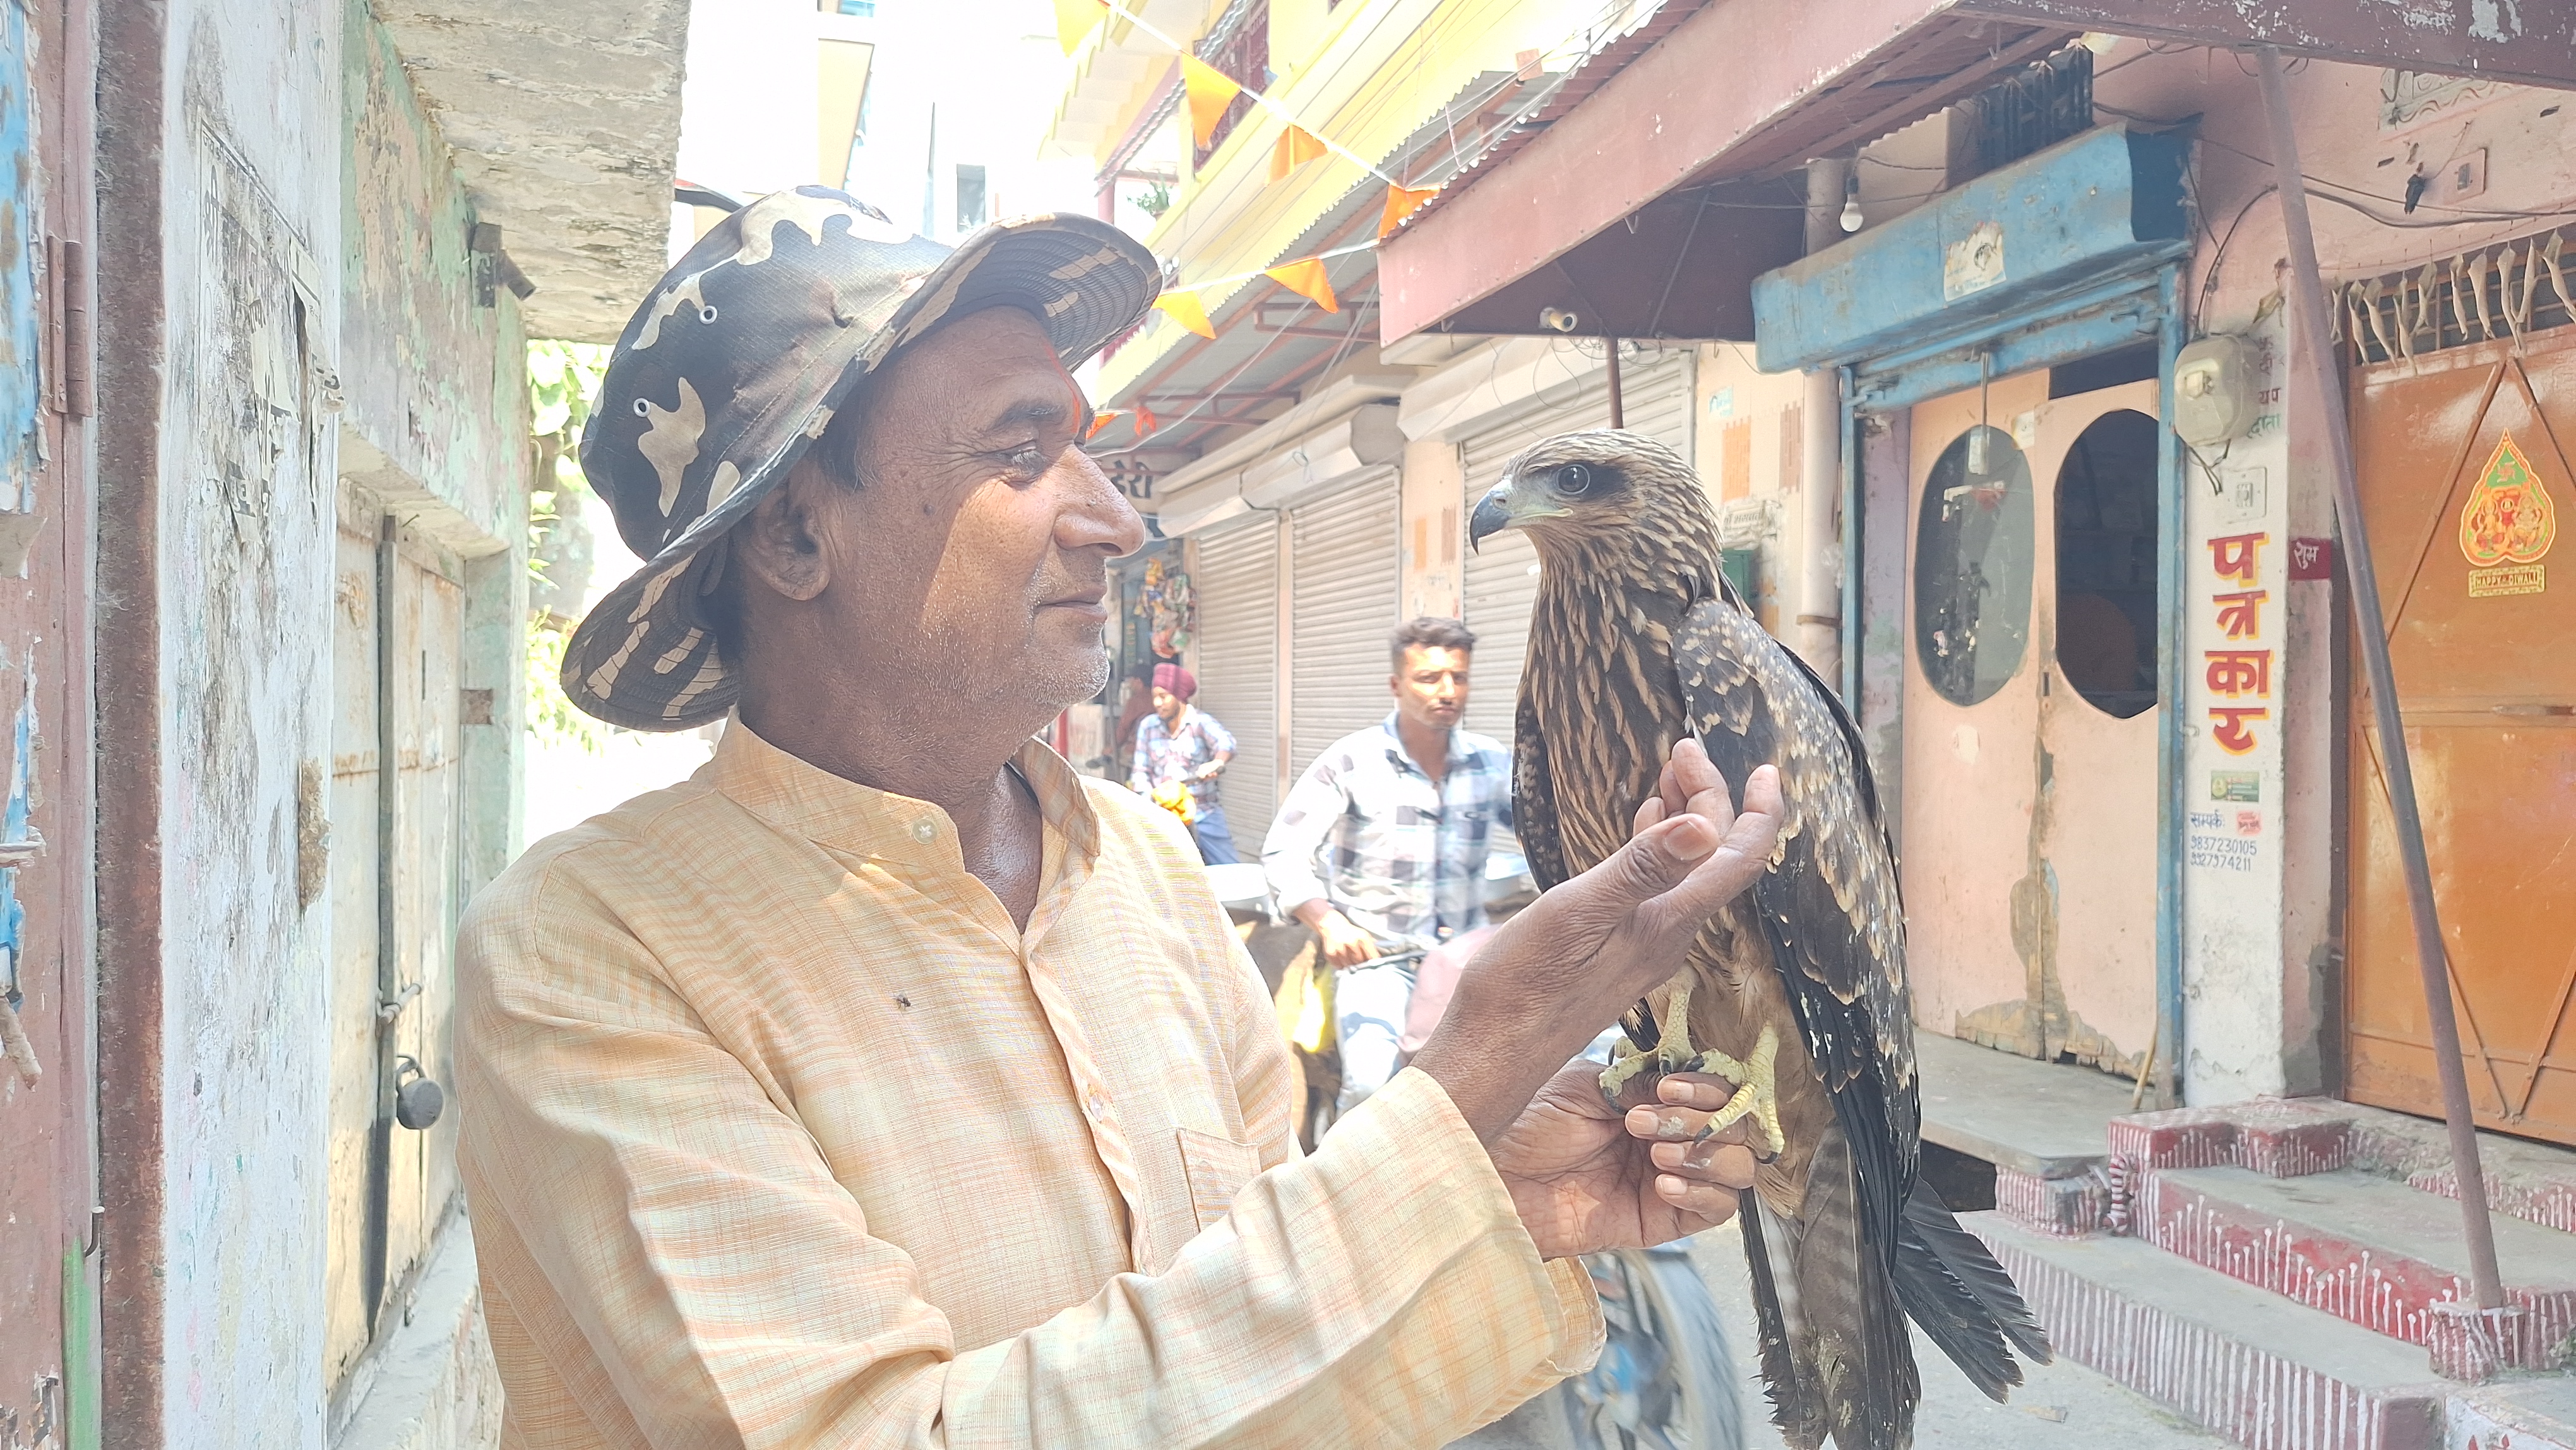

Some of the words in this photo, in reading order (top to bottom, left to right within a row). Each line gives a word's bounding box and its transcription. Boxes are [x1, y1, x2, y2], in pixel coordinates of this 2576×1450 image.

[2475, 575, 2501, 589] HAPPY
[2509, 572, 2537, 585] DIWALI
[2191, 835, 2257, 856] 9837230105
